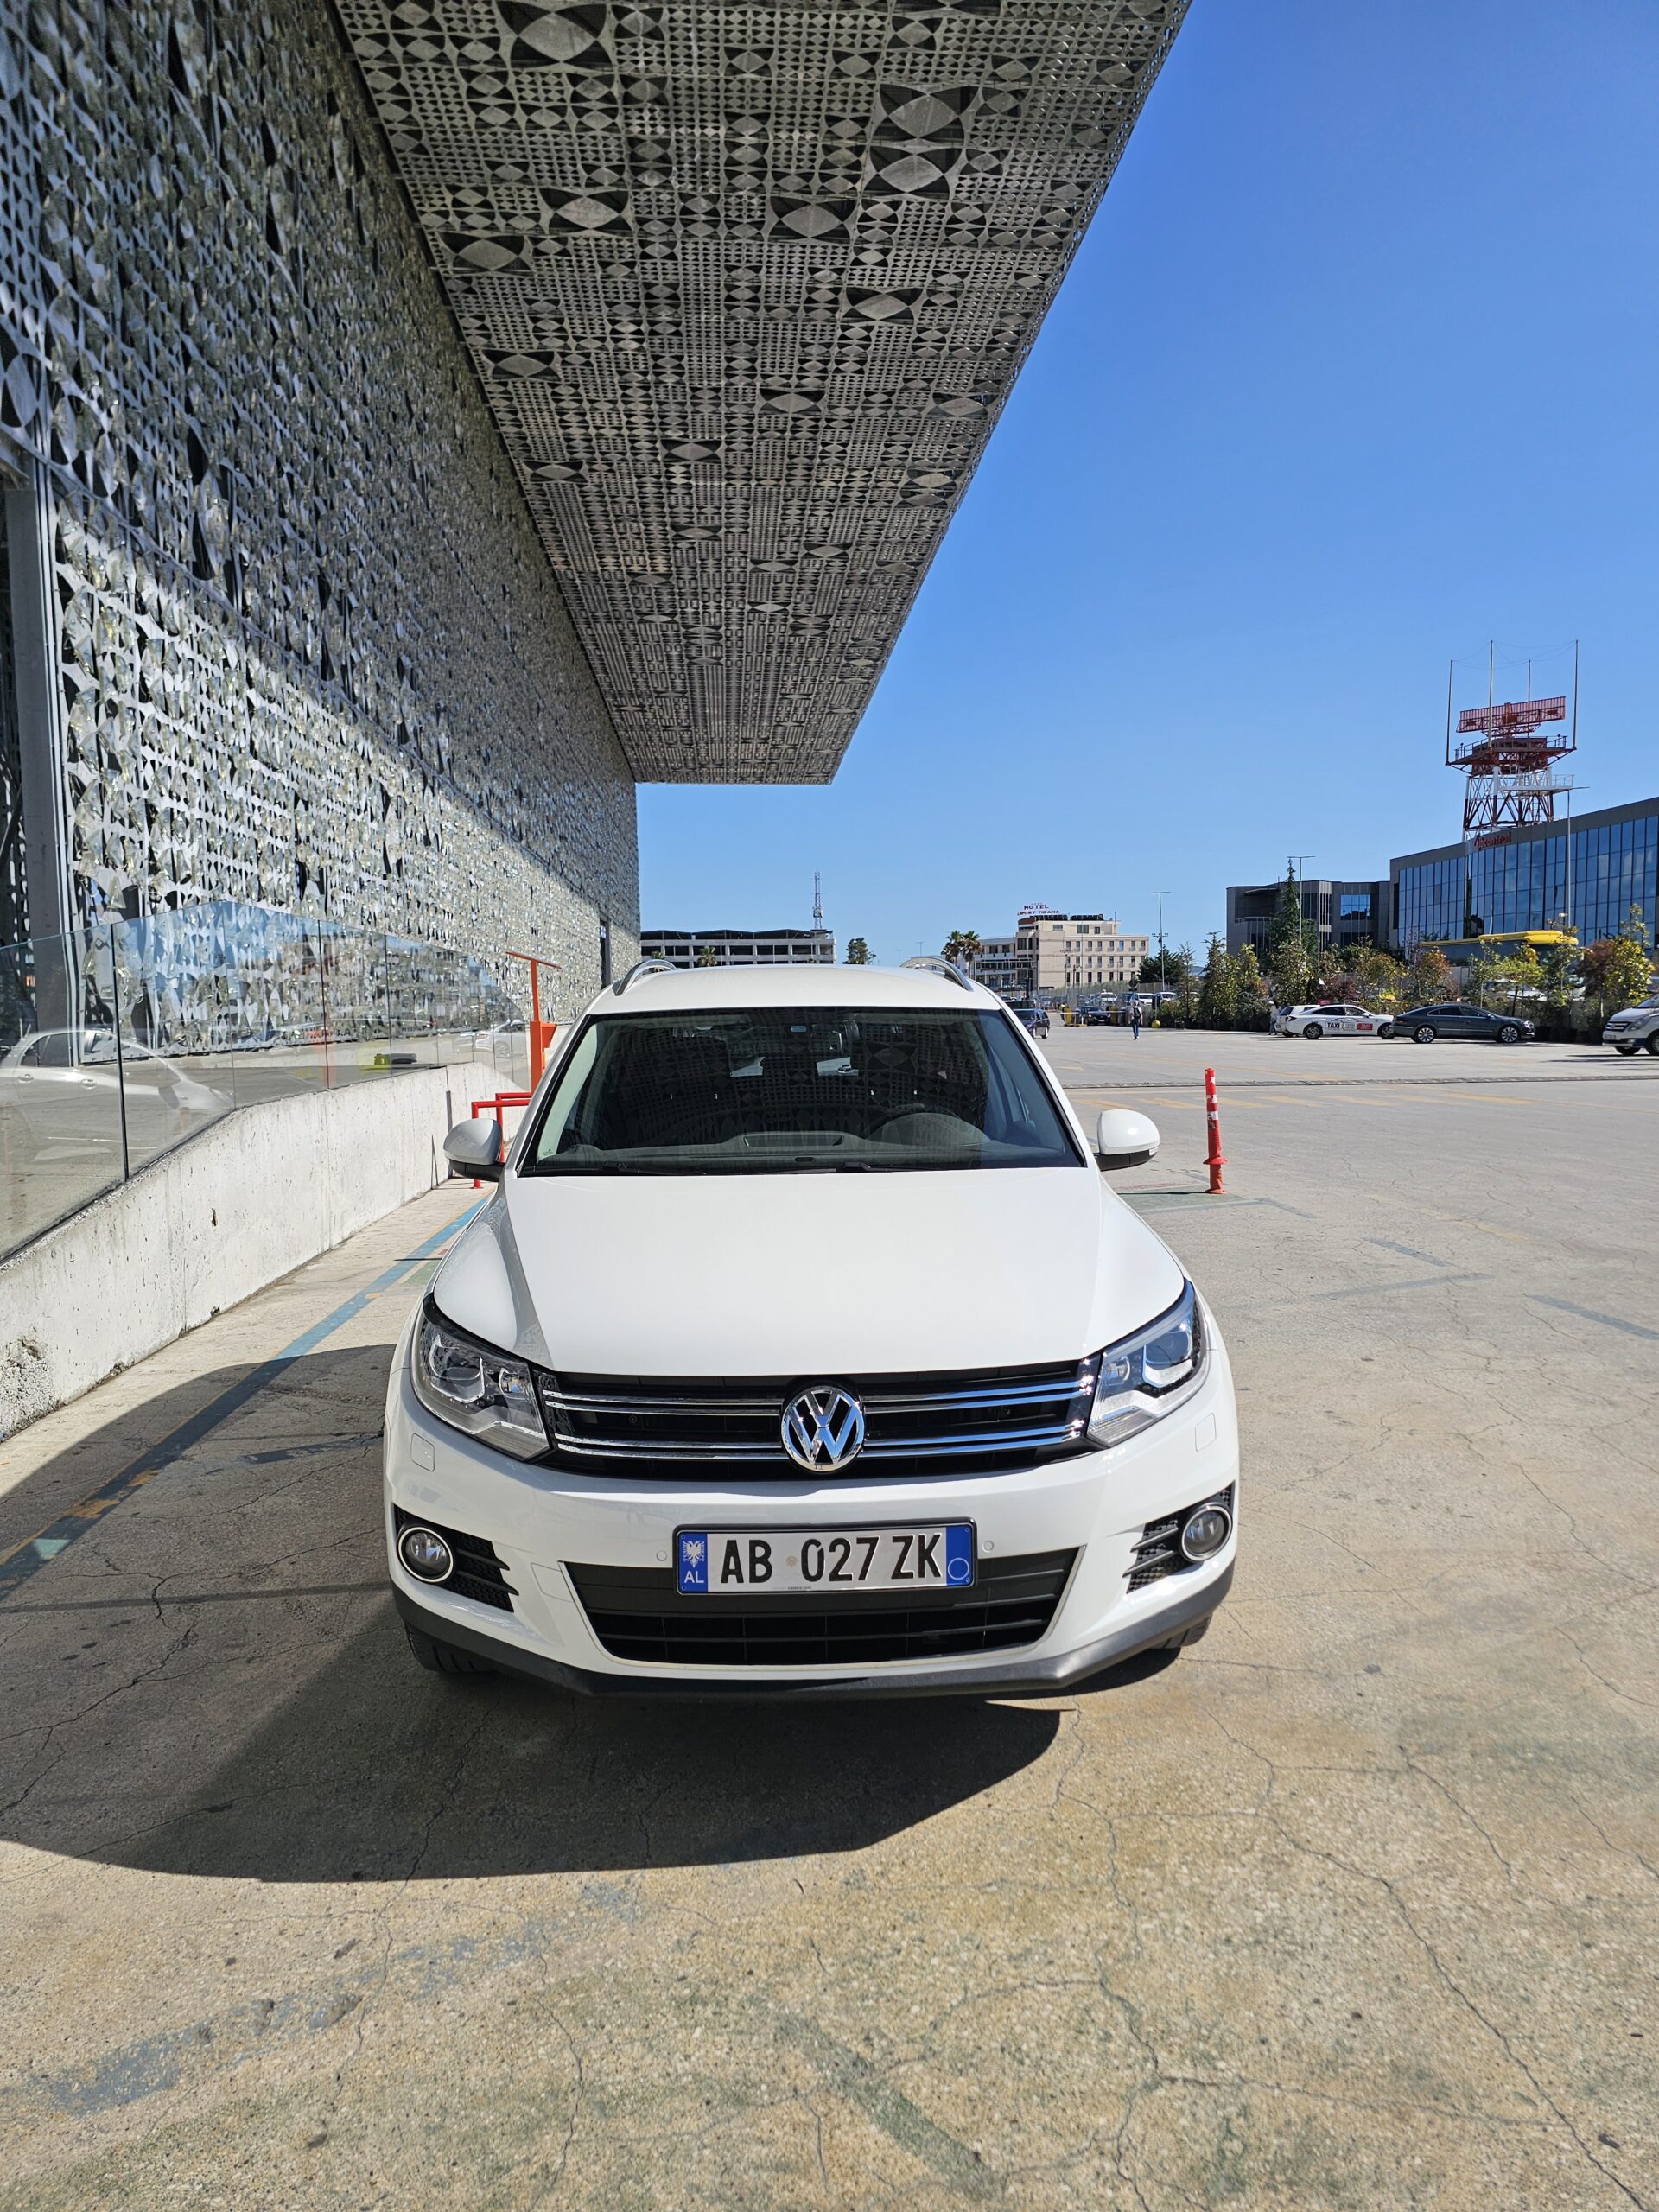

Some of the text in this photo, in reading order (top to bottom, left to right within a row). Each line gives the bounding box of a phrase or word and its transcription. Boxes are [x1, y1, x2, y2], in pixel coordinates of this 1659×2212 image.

[720, 1533, 943, 1584] AB 027 ZK
[683, 1570, 705, 1584] AL
